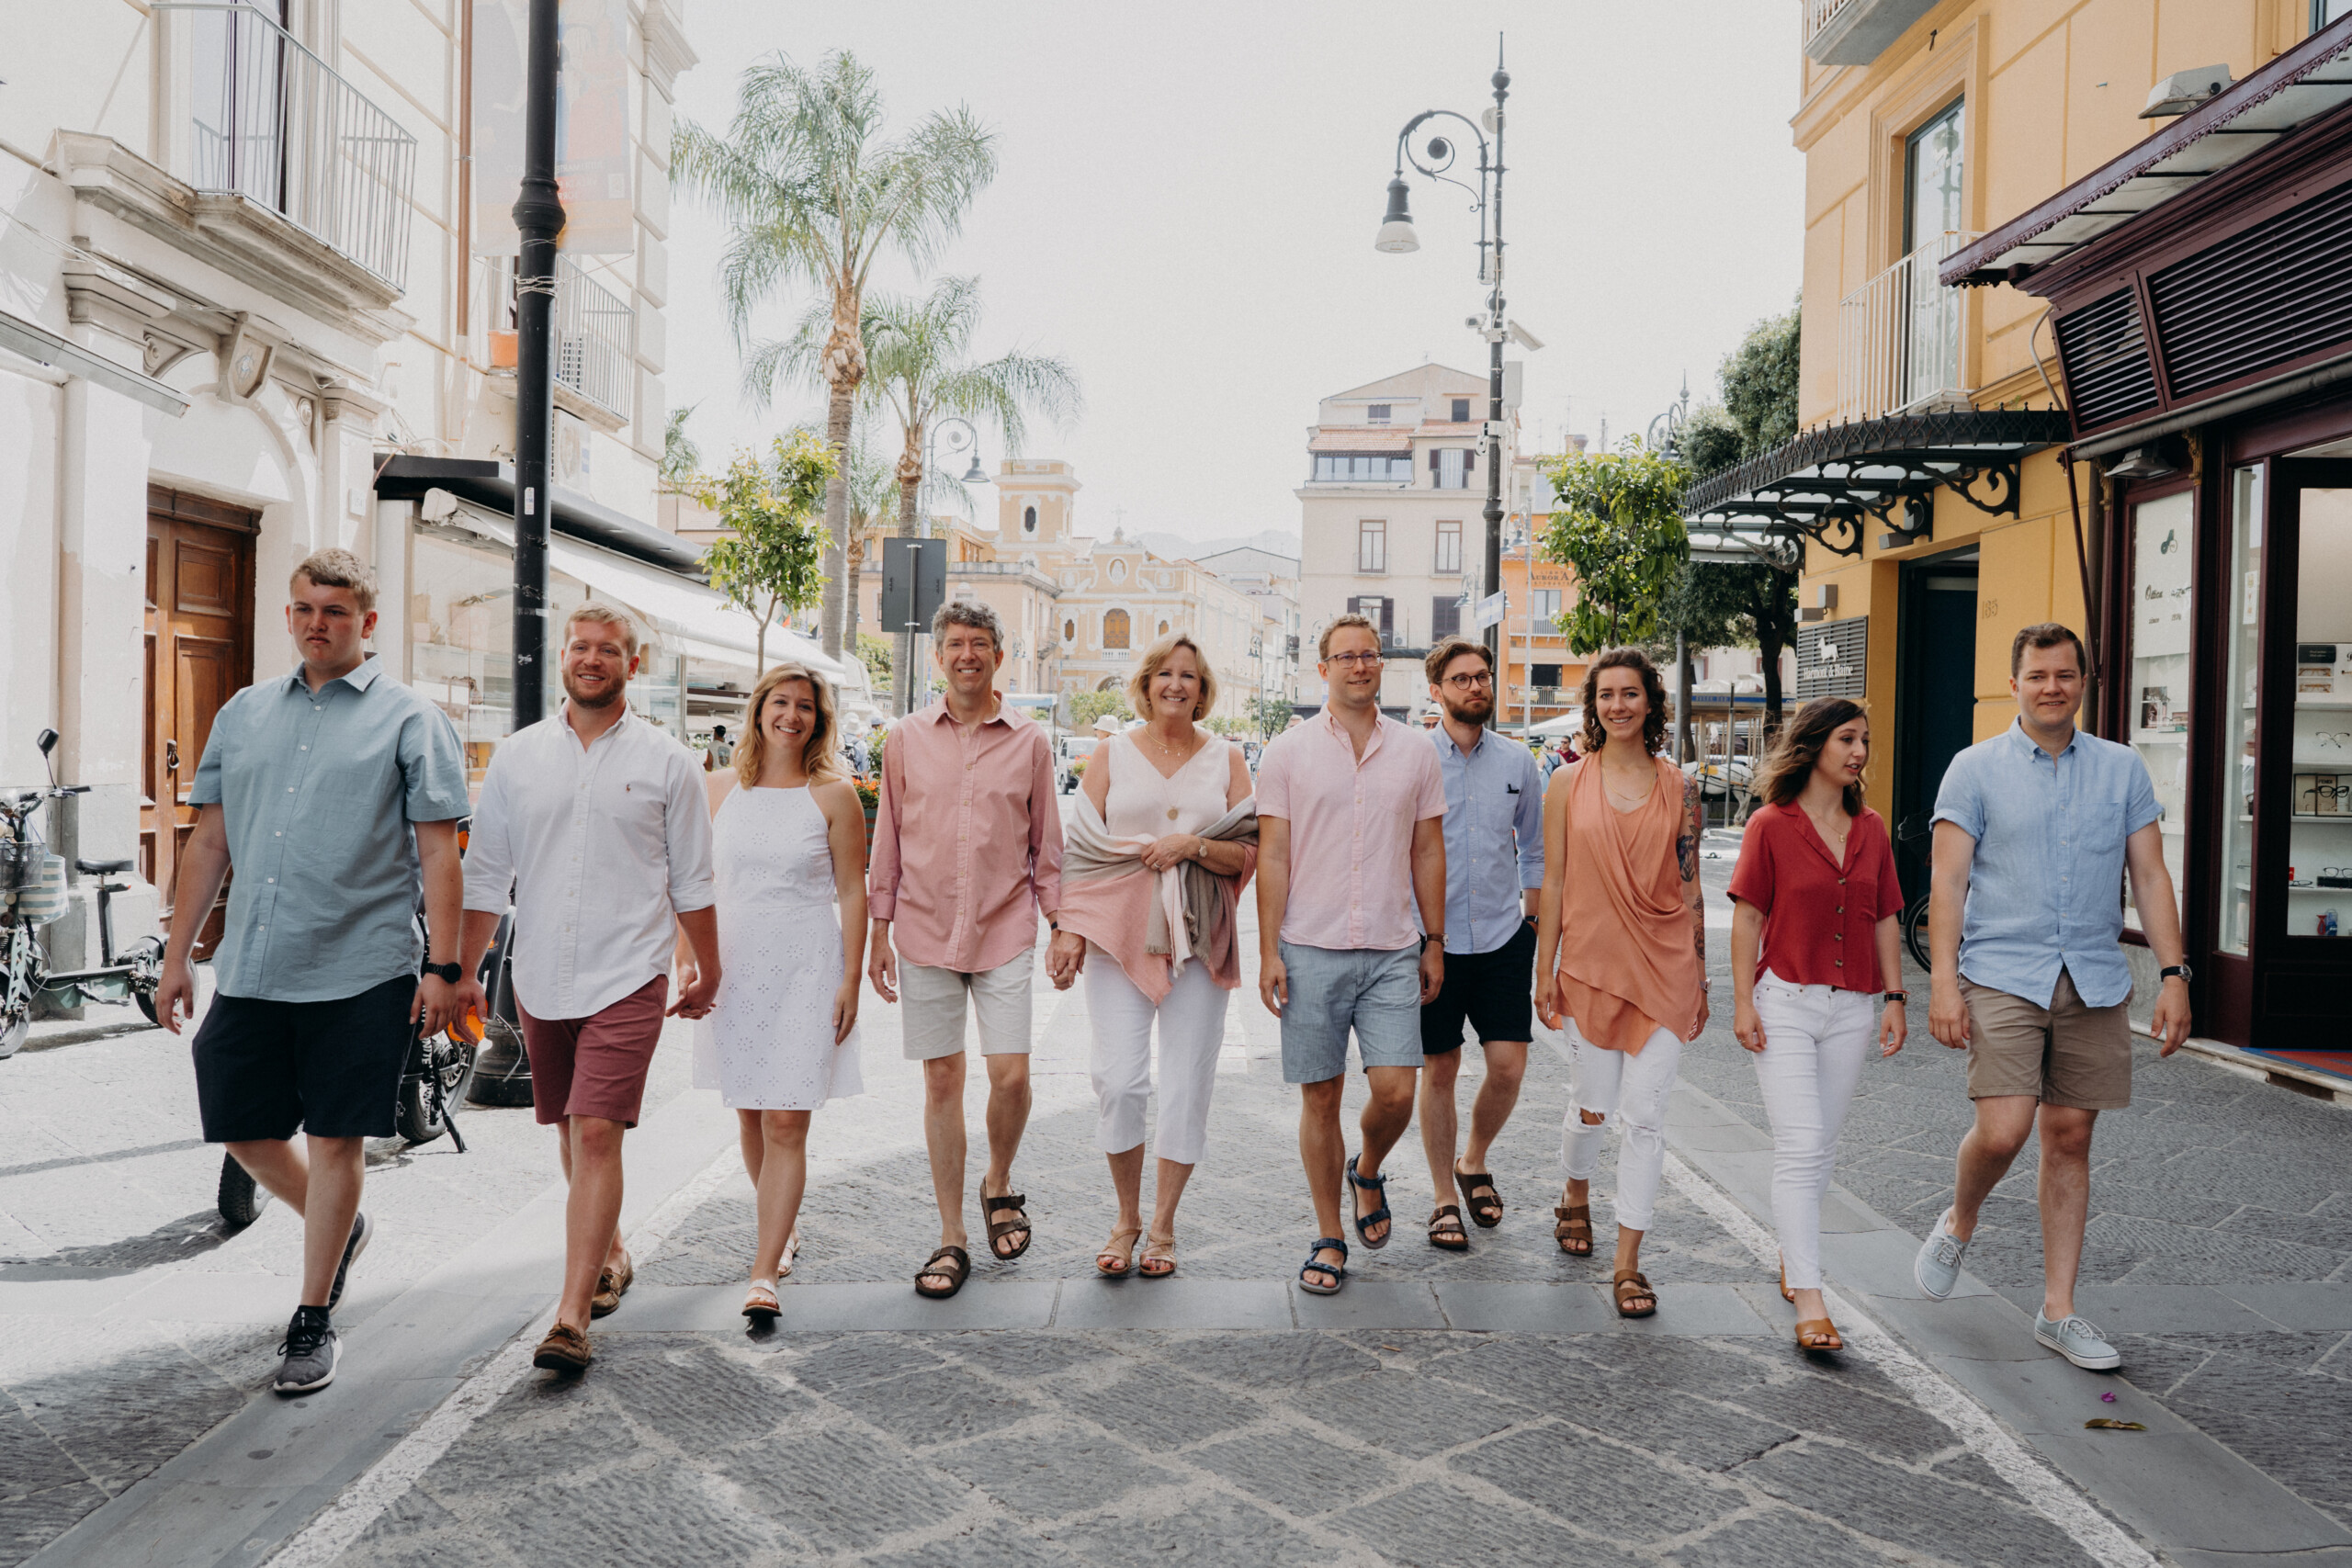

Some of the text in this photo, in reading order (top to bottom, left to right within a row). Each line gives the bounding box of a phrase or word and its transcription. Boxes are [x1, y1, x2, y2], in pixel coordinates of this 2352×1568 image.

[1804, 663, 1853, 680] Harmont & Blaine
